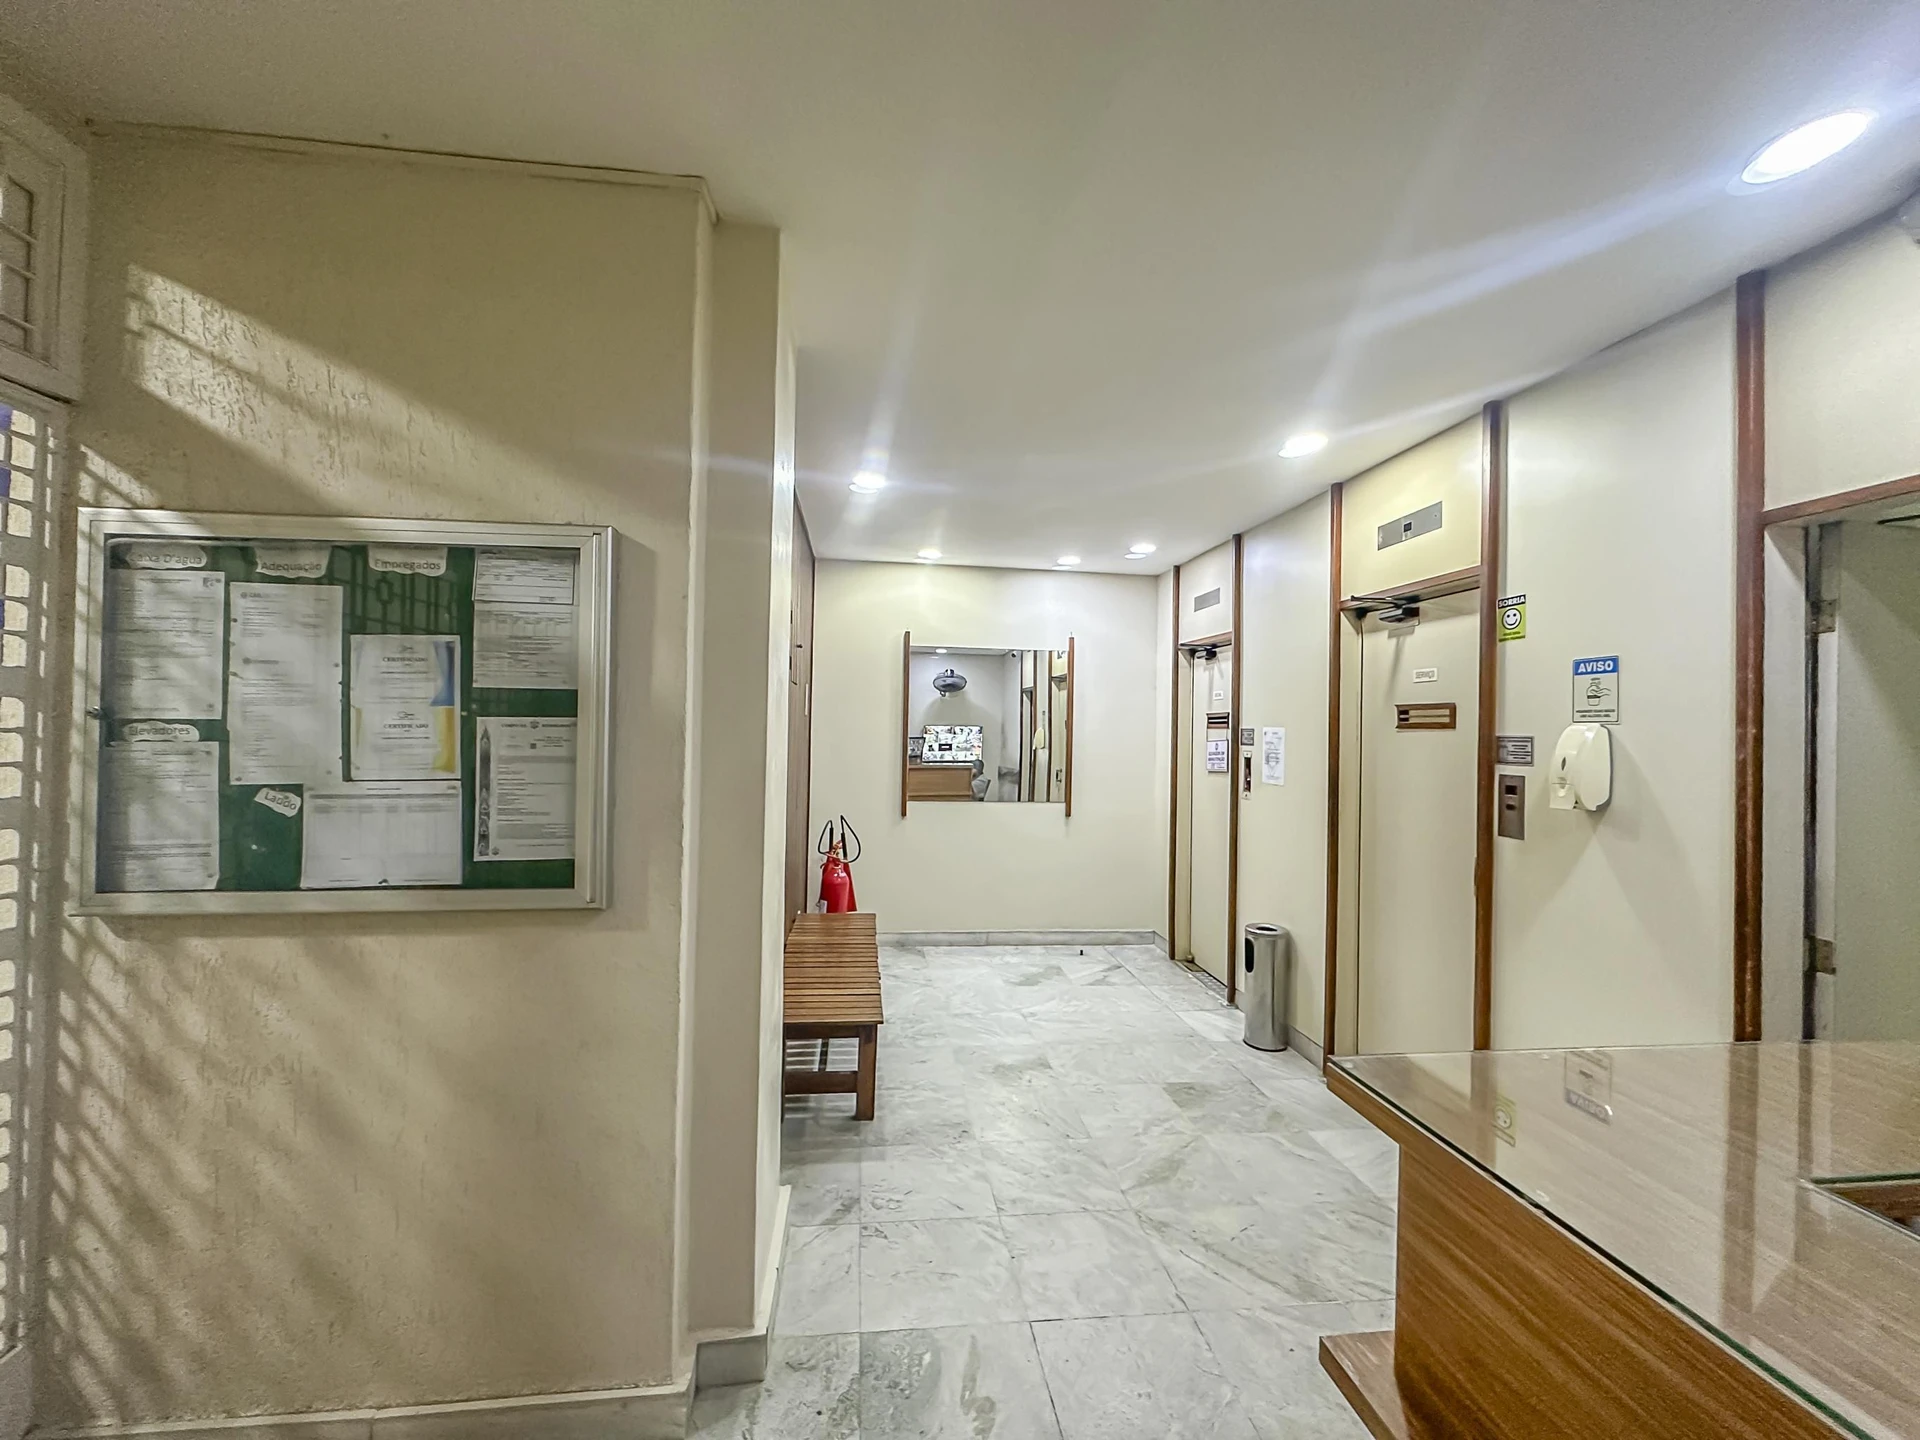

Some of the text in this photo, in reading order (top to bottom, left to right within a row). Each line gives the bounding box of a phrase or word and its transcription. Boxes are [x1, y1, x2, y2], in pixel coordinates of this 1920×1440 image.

[261, 561, 322, 573] Adequação
[374, 559, 441, 571] Empregados
[1498, 596, 1526, 608] SORRIA
[1577, 660, 1614, 673] AVISO
[128, 726, 191, 736] Elevadores
[264, 791, 297, 810] Laudo
